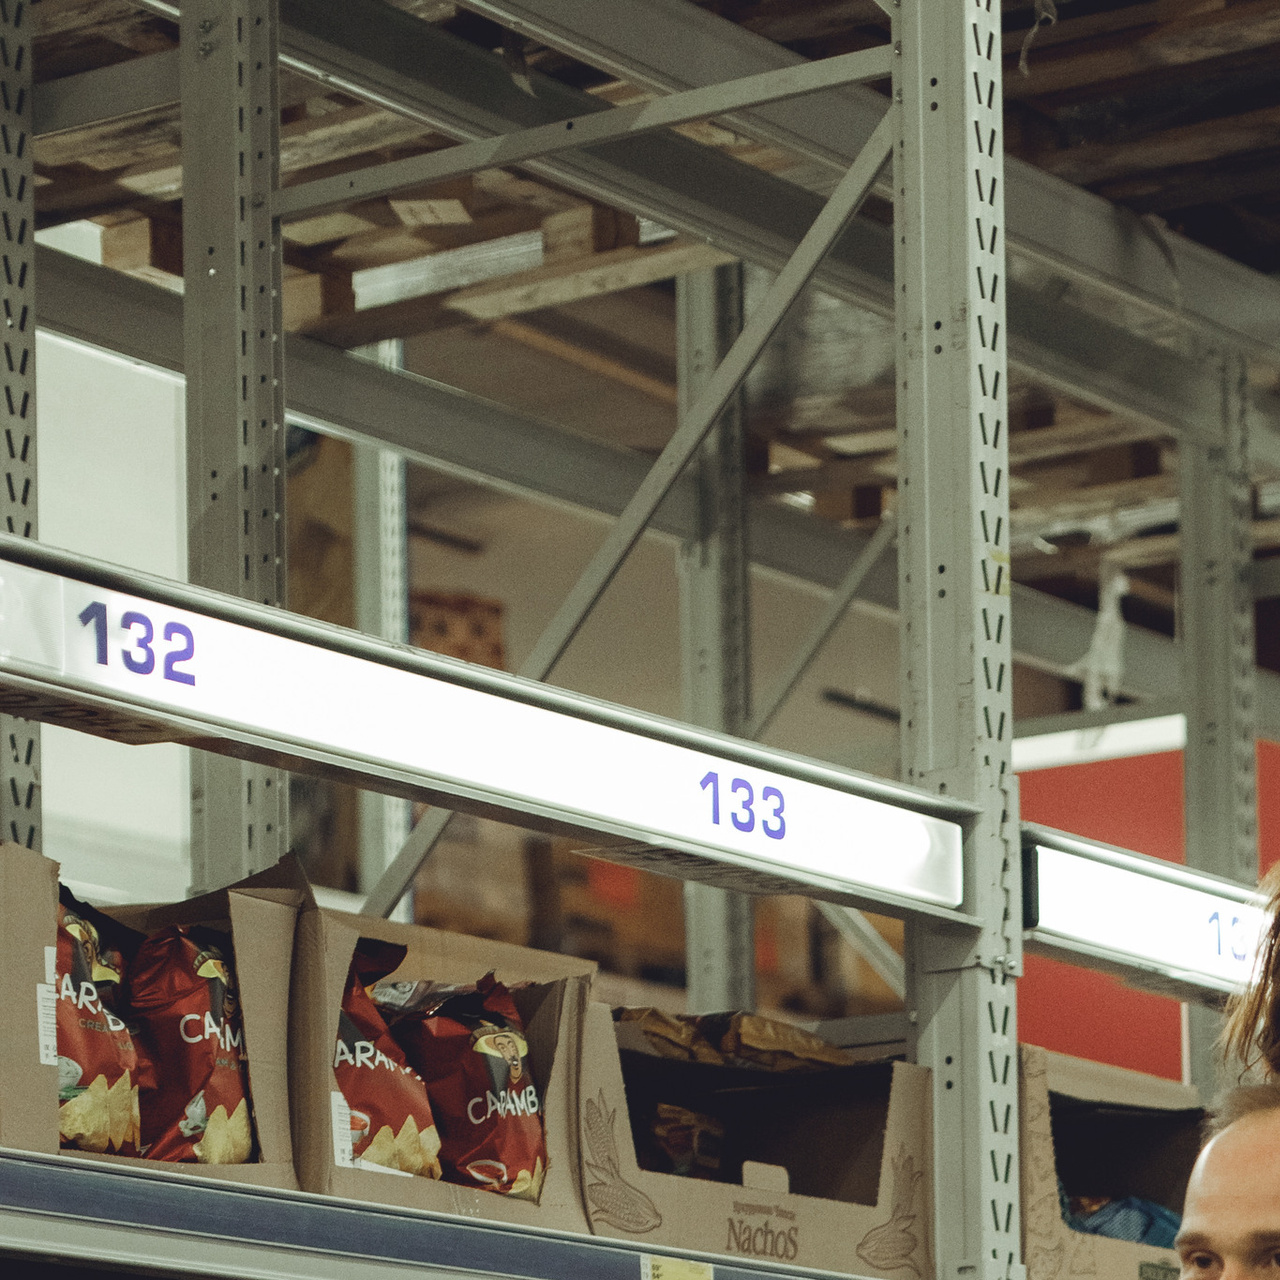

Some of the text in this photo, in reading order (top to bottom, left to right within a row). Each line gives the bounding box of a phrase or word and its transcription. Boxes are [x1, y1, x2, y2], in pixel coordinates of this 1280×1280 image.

[78, 600, 196, 687] 132
[699, 771, 786, 840] 133
[725, 1217, 799, 1261] Nachos
